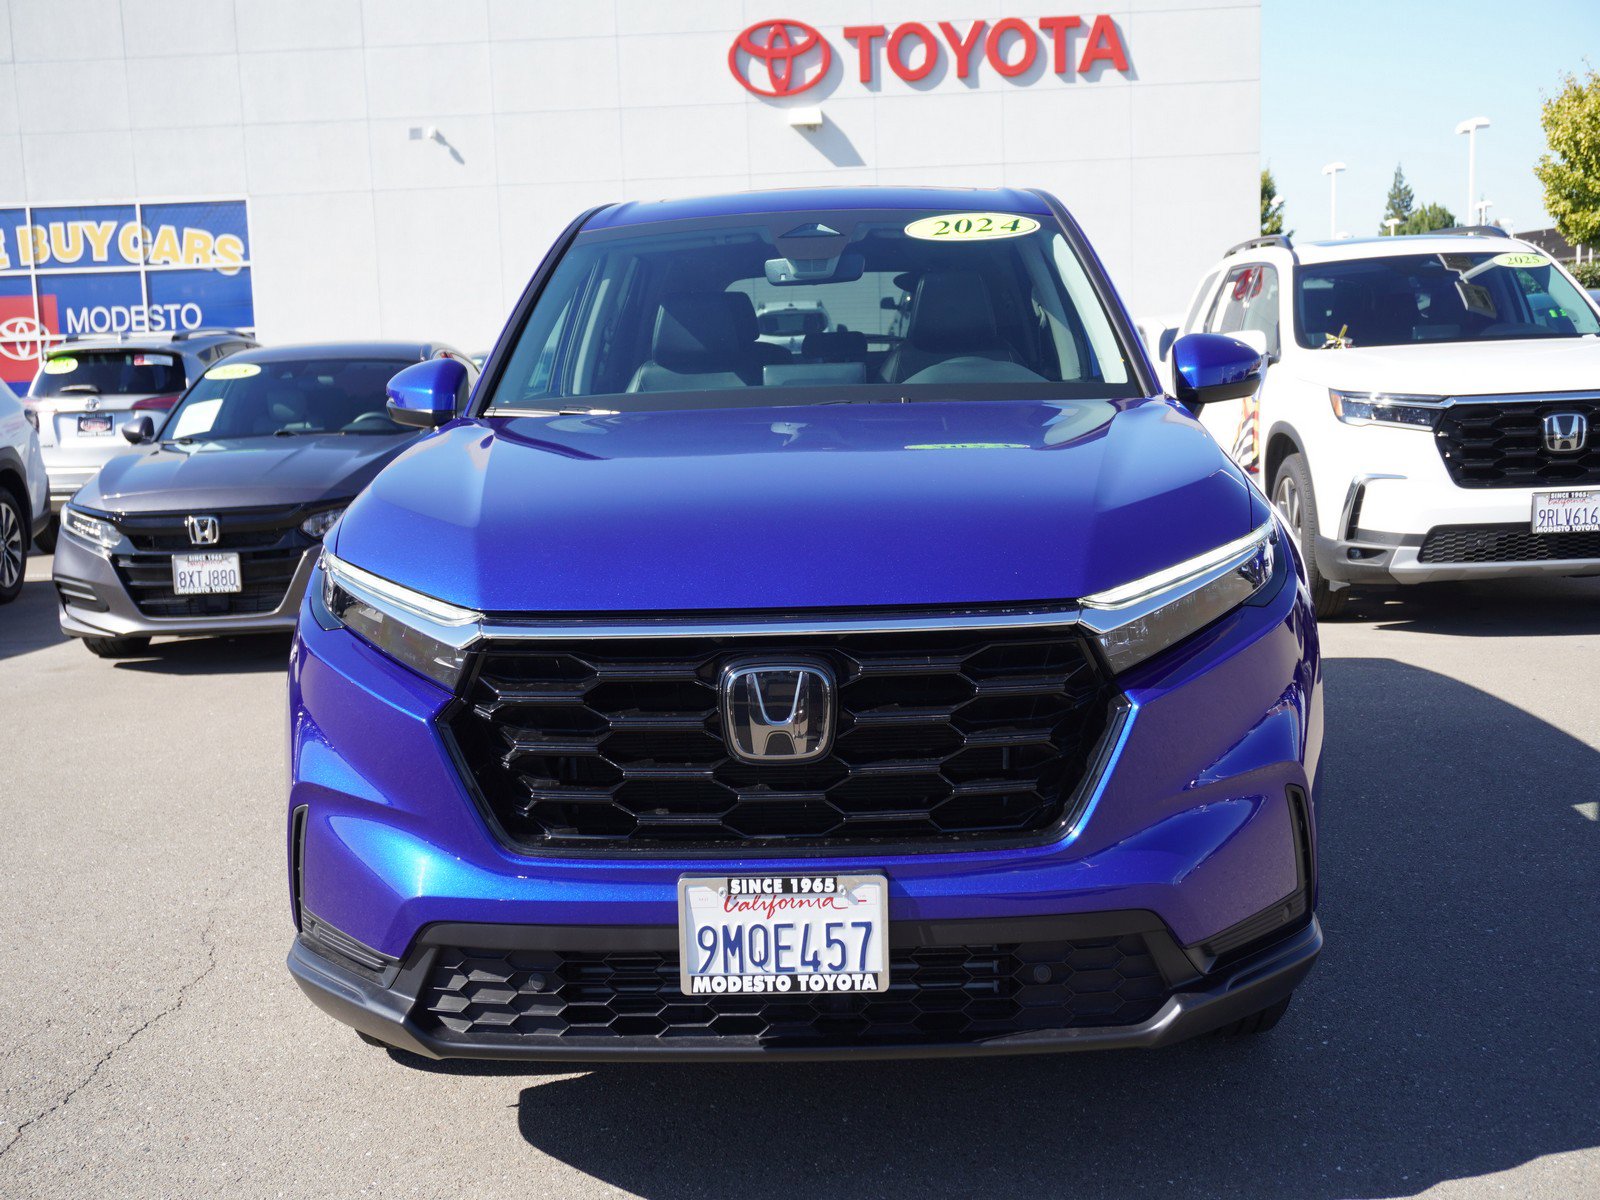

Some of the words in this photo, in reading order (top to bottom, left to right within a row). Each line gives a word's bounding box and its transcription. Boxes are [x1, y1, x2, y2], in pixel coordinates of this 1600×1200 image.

[843, 14, 1130, 84] TOYOTA
[933, 217, 1021, 236] 2024
[16, 221, 117, 266] BUY
[118, 221, 244, 275] CARS
[1506, 255, 1540, 265] 2025
[67, 303, 202, 333] MODESTO
[1538, 507, 1599, 527] 9RLV616
[1536, 525, 1570, 533] MODESTO
[1572, 523, 1599, 531] TOYOTA
[178, 569, 237, 588] 8XTJ880
[730, 879, 783, 894] SINCE
[790, 878, 835, 892] 1965
[723, 895, 848, 919] California
[697, 921, 873, 974] 9MQE457
[692, 976, 792, 993] MODESTO
[797, 973, 878, 992] TOYOTA
